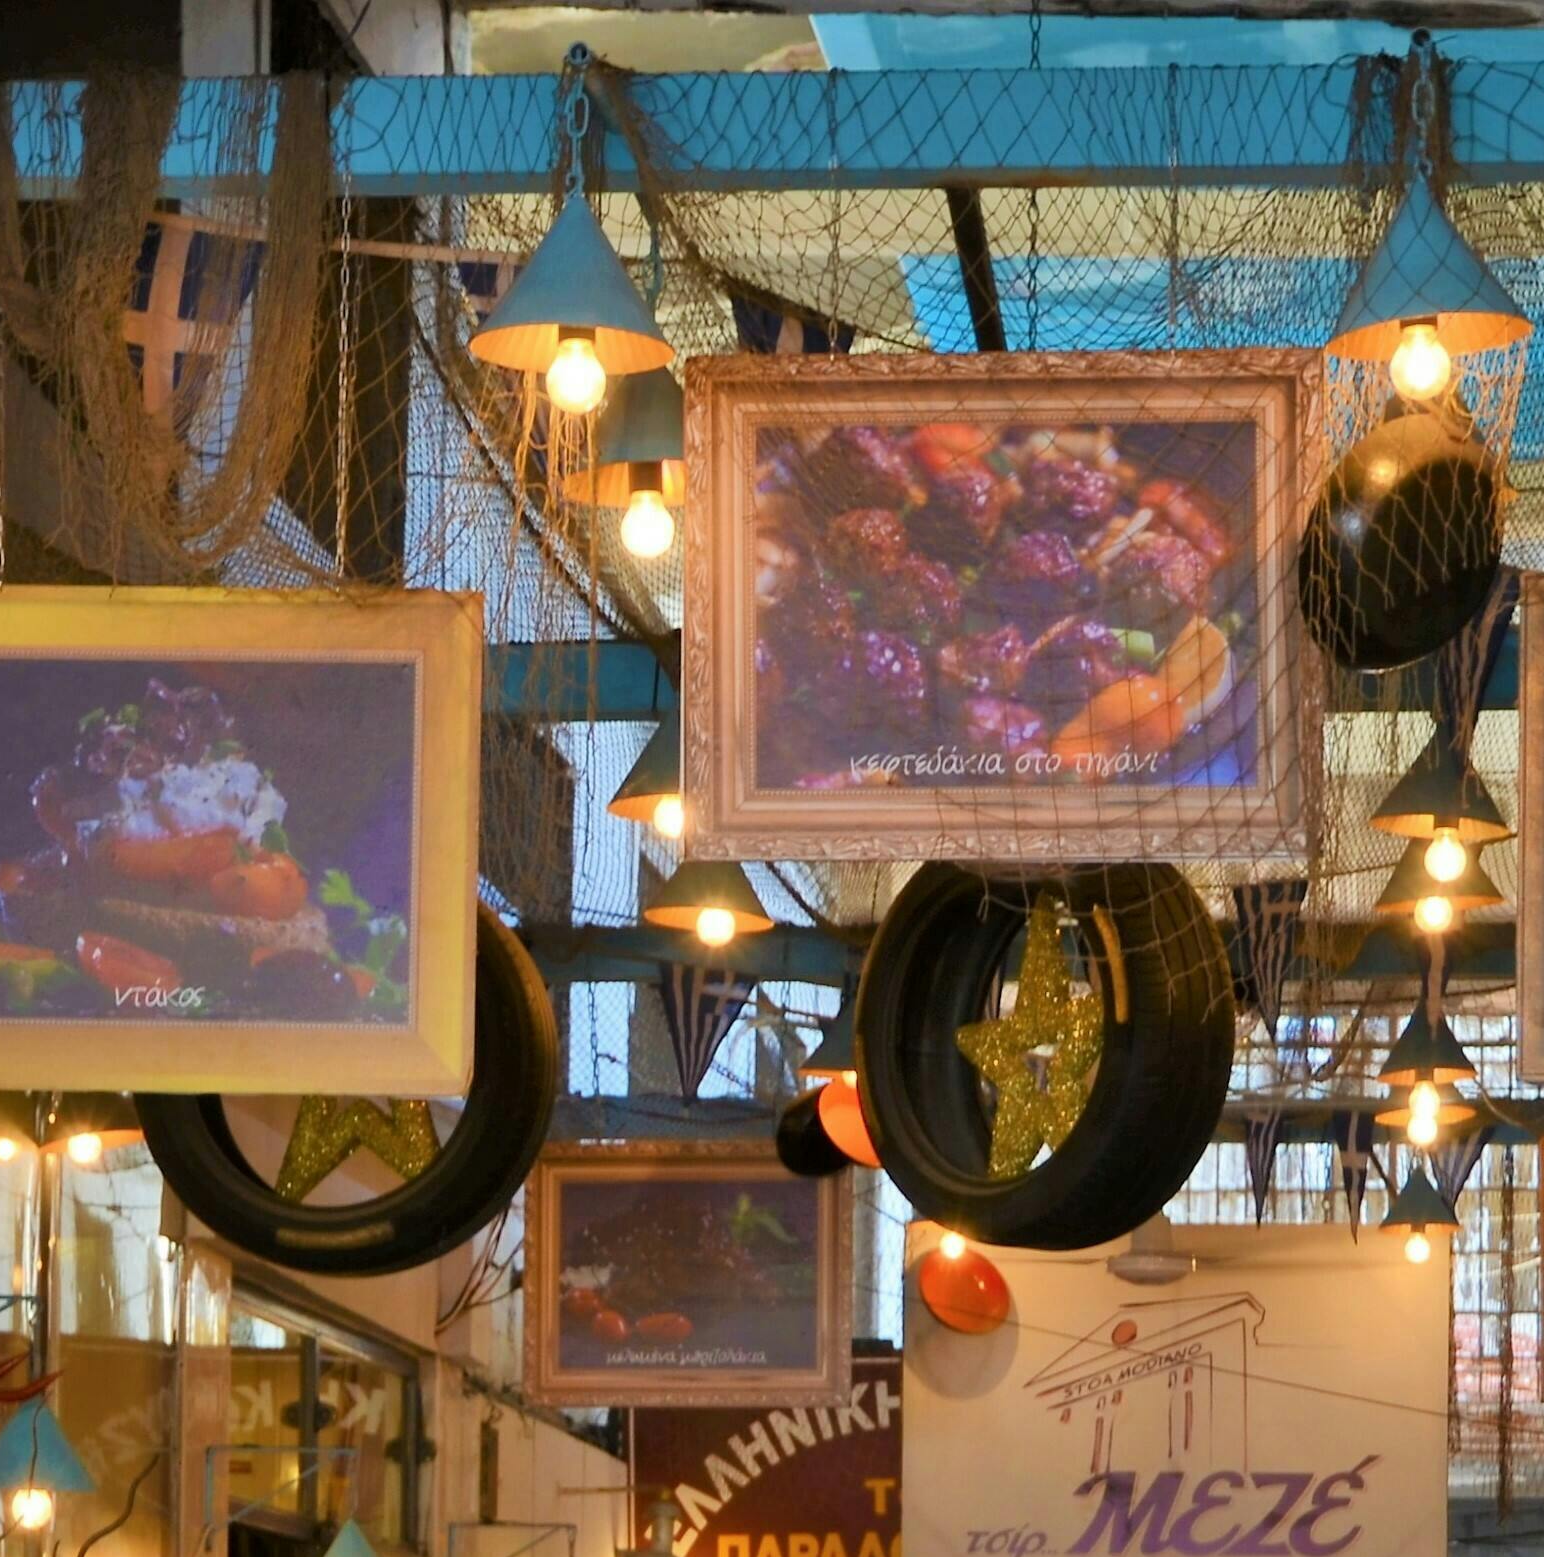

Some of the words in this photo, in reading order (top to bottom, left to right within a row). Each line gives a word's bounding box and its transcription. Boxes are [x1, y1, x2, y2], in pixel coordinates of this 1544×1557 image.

[849, 745, 1006, 783] κεφτεδάκια
[1014, 752, 1060, 775] στο
[1073, 744, 1160, 778] τηγάνι
[113, 976, 208, 1010] ντάκος
[1118, 1343, 1204, 1382] MODIANO
[865, 1478, 902, 1515] Τ
